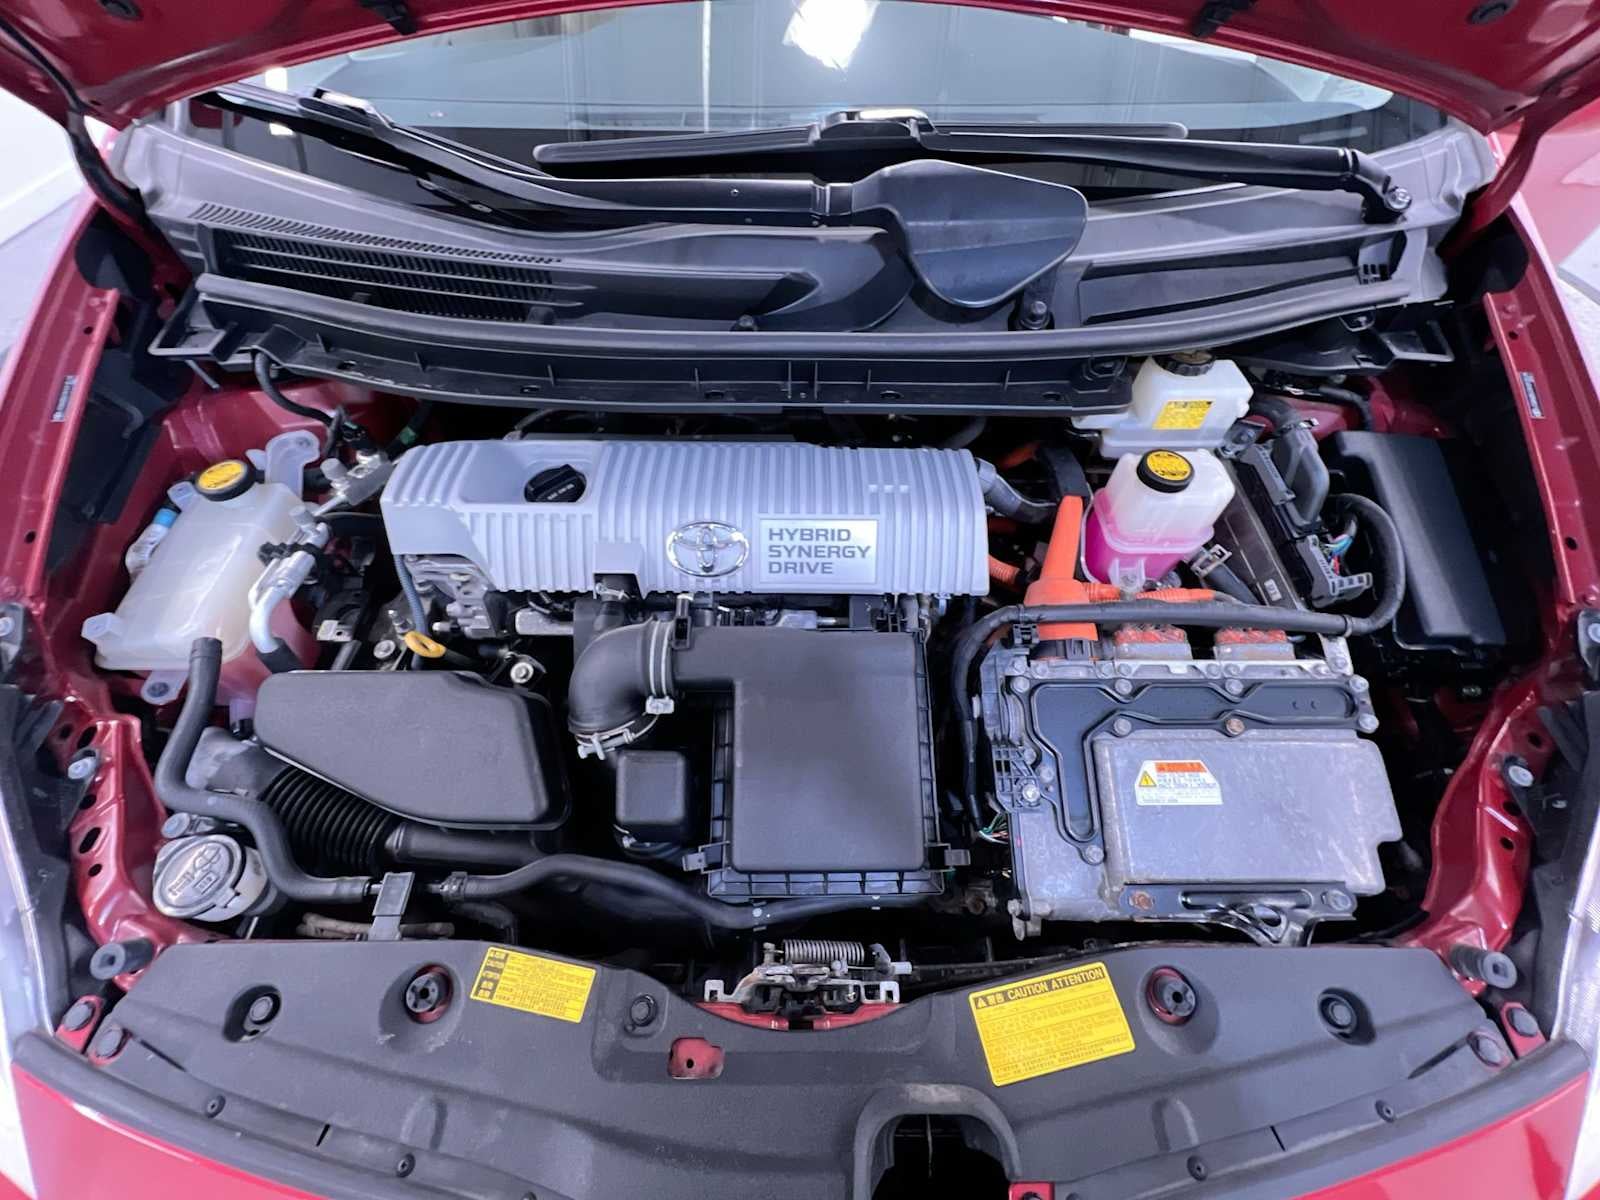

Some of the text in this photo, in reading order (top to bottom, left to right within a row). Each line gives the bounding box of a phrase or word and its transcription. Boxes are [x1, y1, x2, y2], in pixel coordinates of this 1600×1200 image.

[768, 528, 850, 541] HYBRID
[768, 545, 870, 558] SYNERGY
[768, 562, 833, 574] DRIVE
[1007, 981, 1049, 1001] CAUTION
[1050, 968, 1104, 991] ATTENTION
